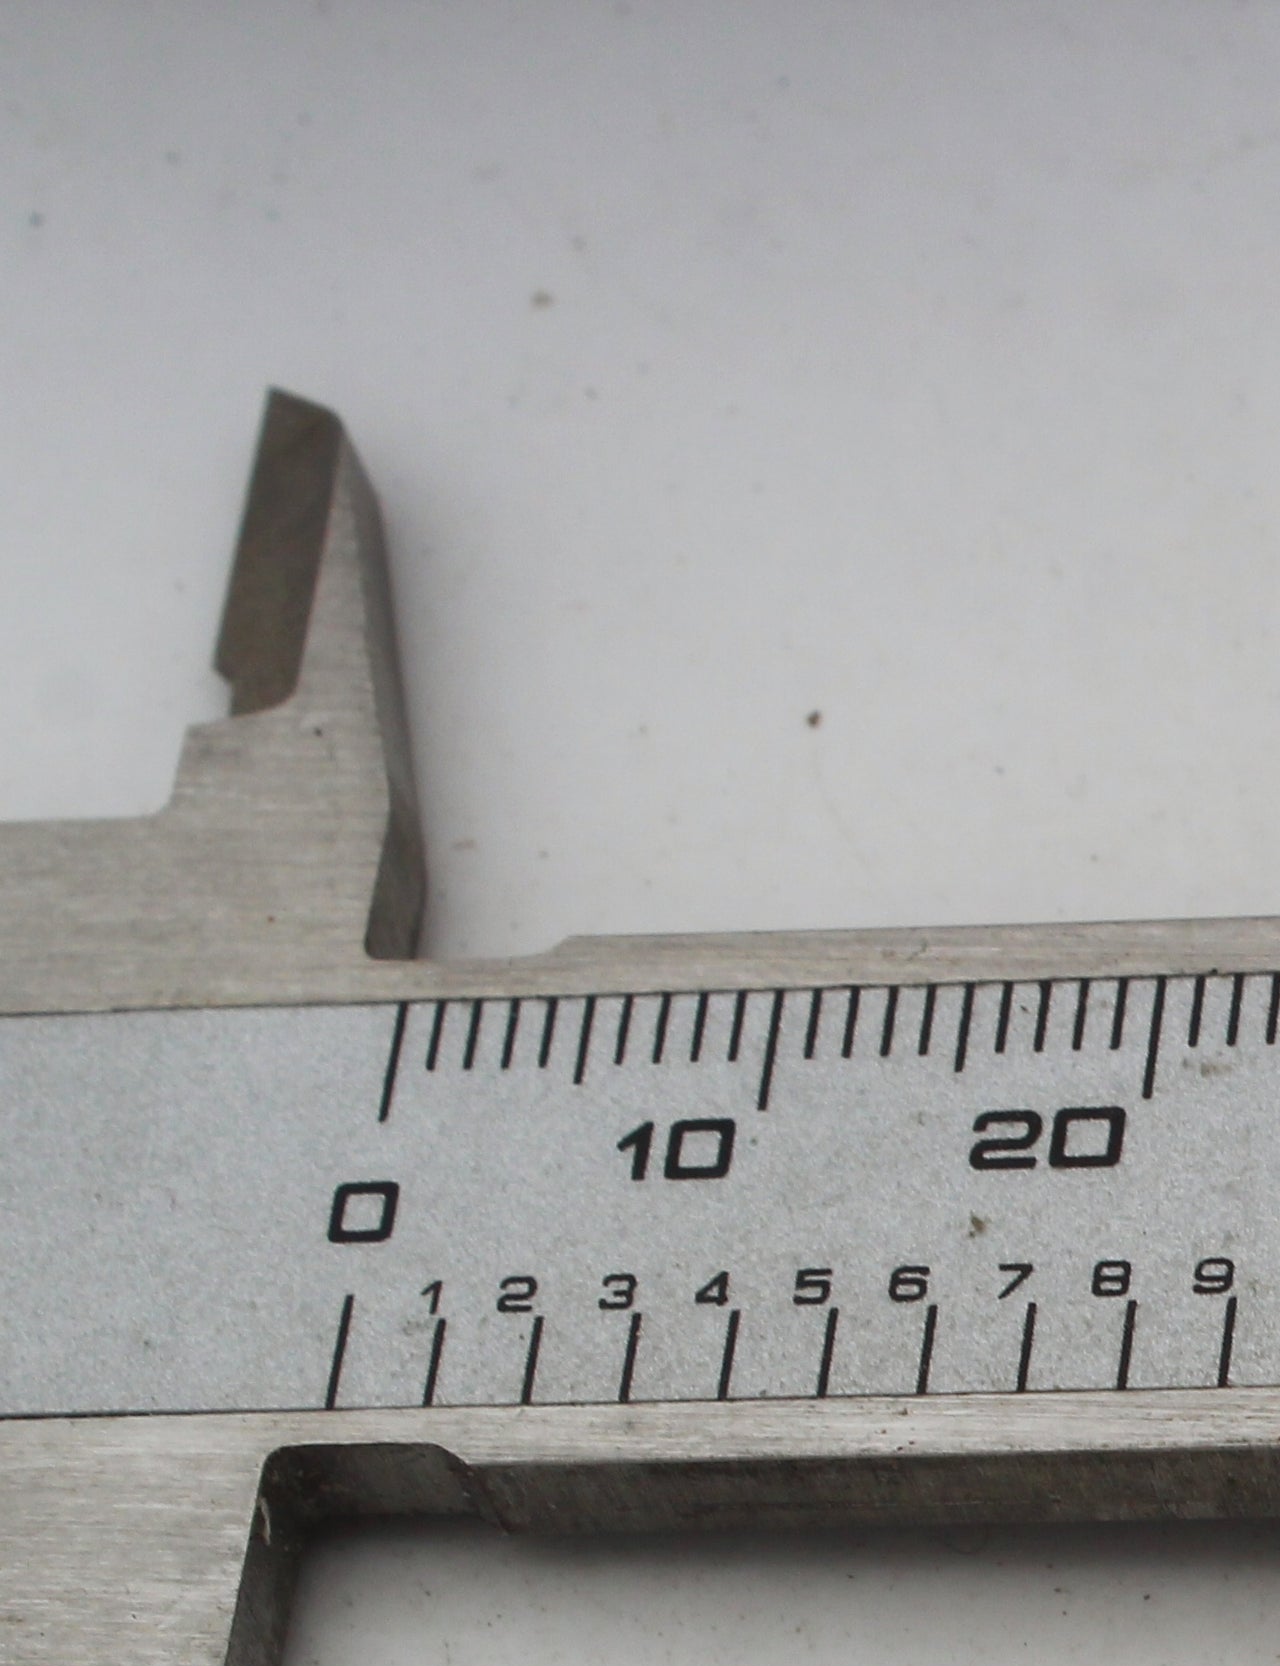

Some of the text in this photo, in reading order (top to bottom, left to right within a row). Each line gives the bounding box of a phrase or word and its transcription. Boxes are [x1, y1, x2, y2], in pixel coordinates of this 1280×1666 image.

[328, 1181, 400, 1244] 0
[616, 1118, 736, 1182] 10
[969, 1106, 1127, 1172] 20
[420, 1281, 444, 1317] 1
[496, 1276, 539, 1314] 2
[599, 1273, 639, 1311] 3
[694, 1271, 731, 1307] 4
[793, 1268, 833, 1305] 5
[888, 1265, 931, 1303] 6
[997, 1263, 1035, 1300] 7
[1091, 1260, 1132, 1298] 8
[1193, 1258, 1236, 1295] 9
